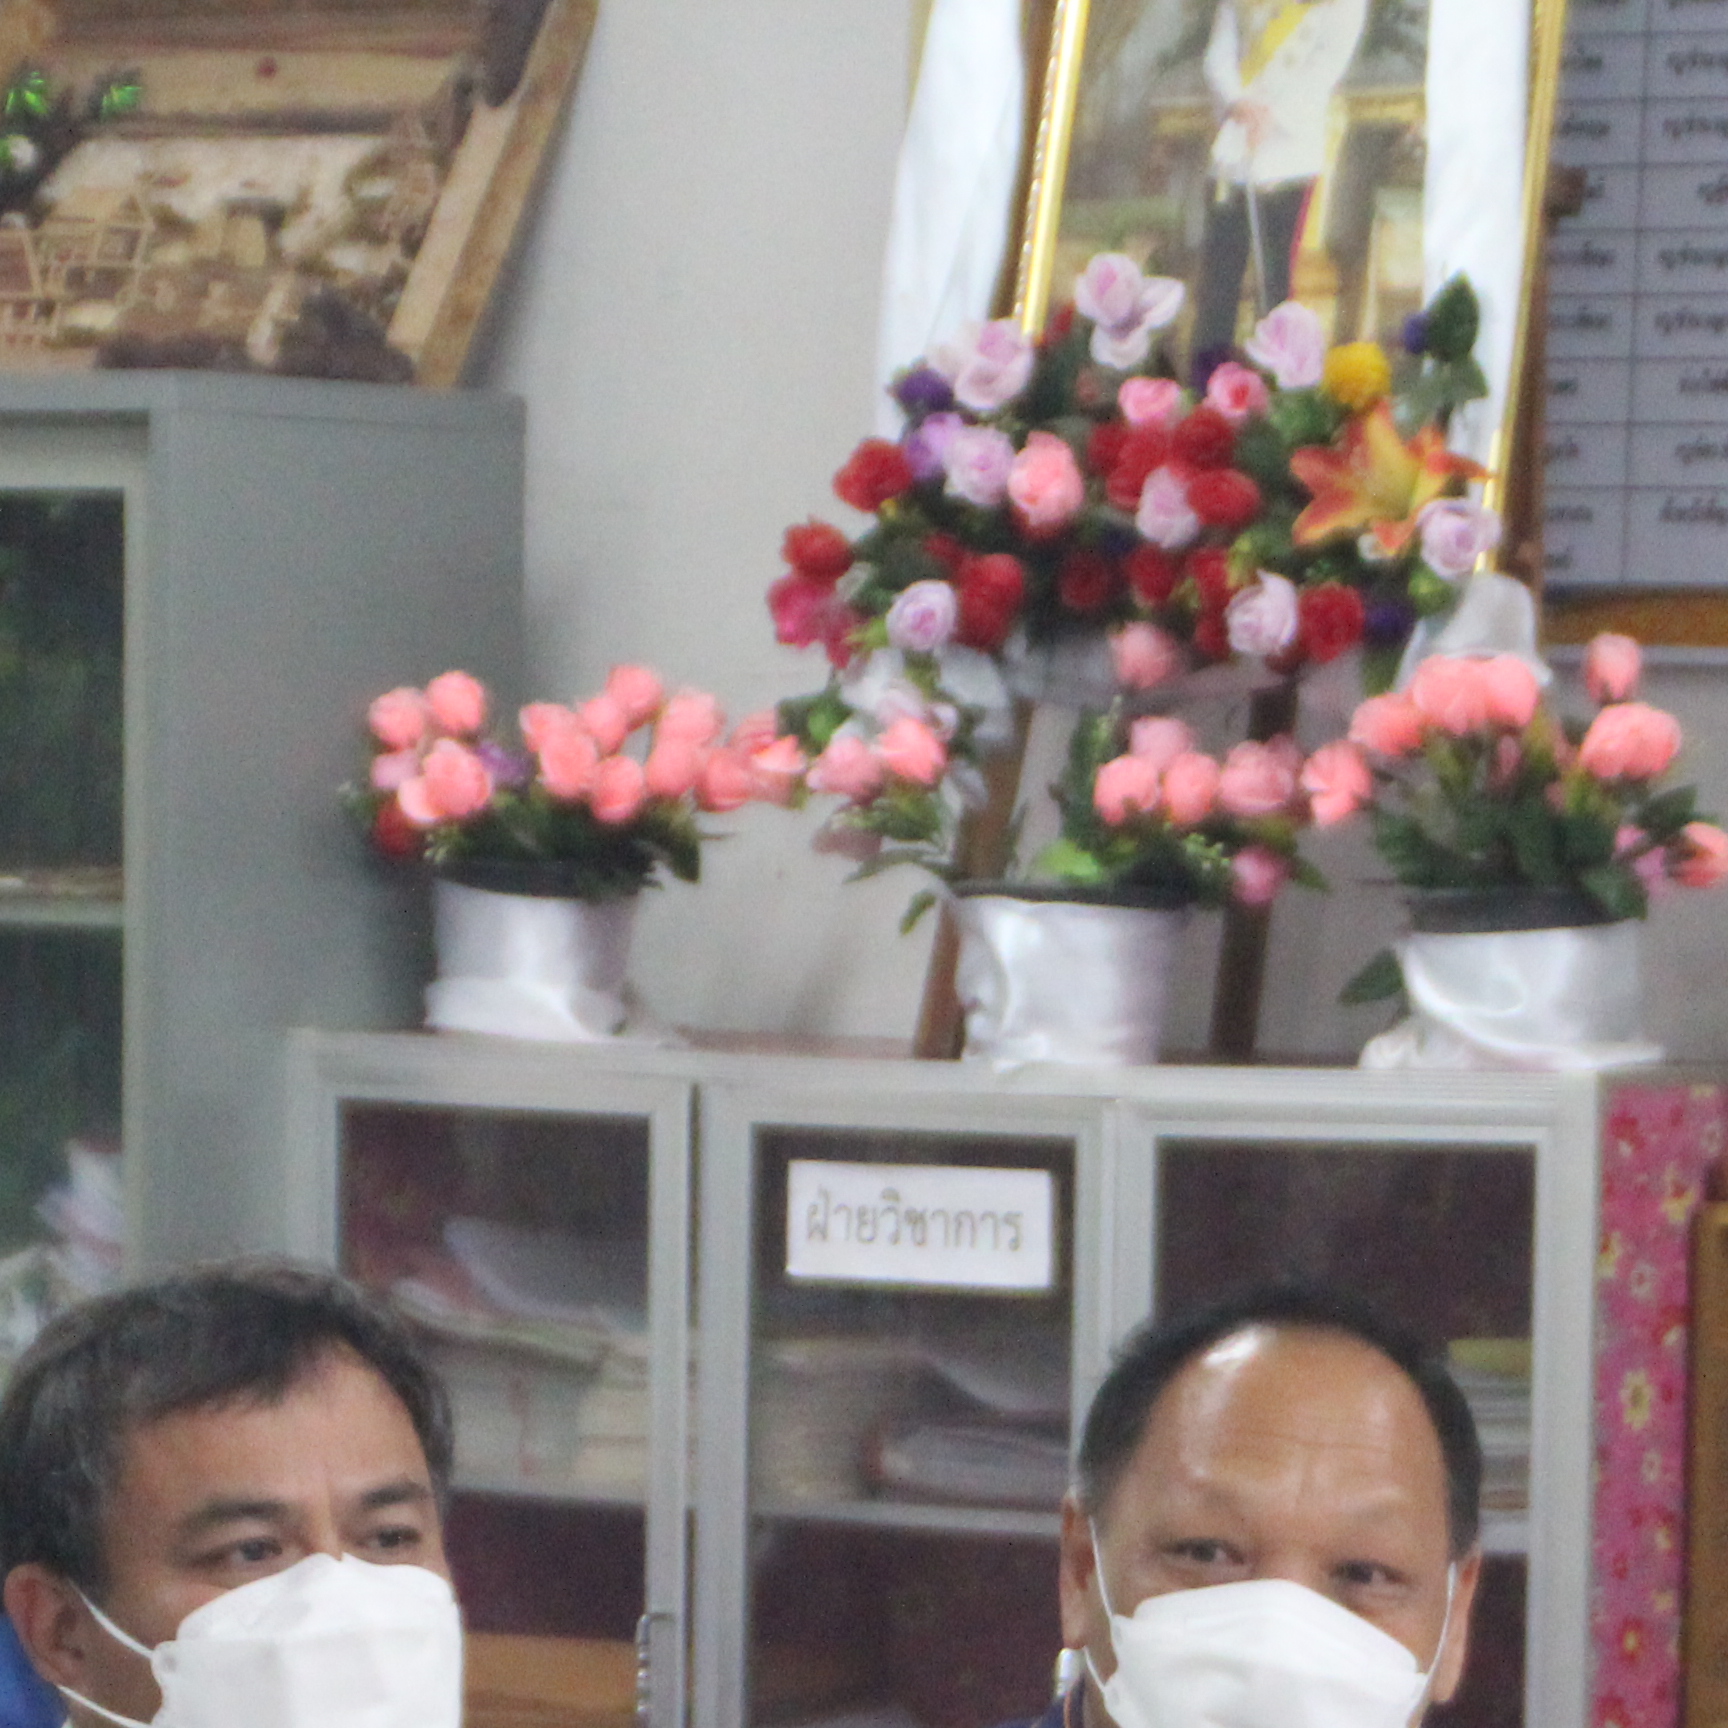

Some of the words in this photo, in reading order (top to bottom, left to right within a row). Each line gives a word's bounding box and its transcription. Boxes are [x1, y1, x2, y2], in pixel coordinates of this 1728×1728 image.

[806, 1185, 1024, 1252] ฝ่ายวิชาการ
